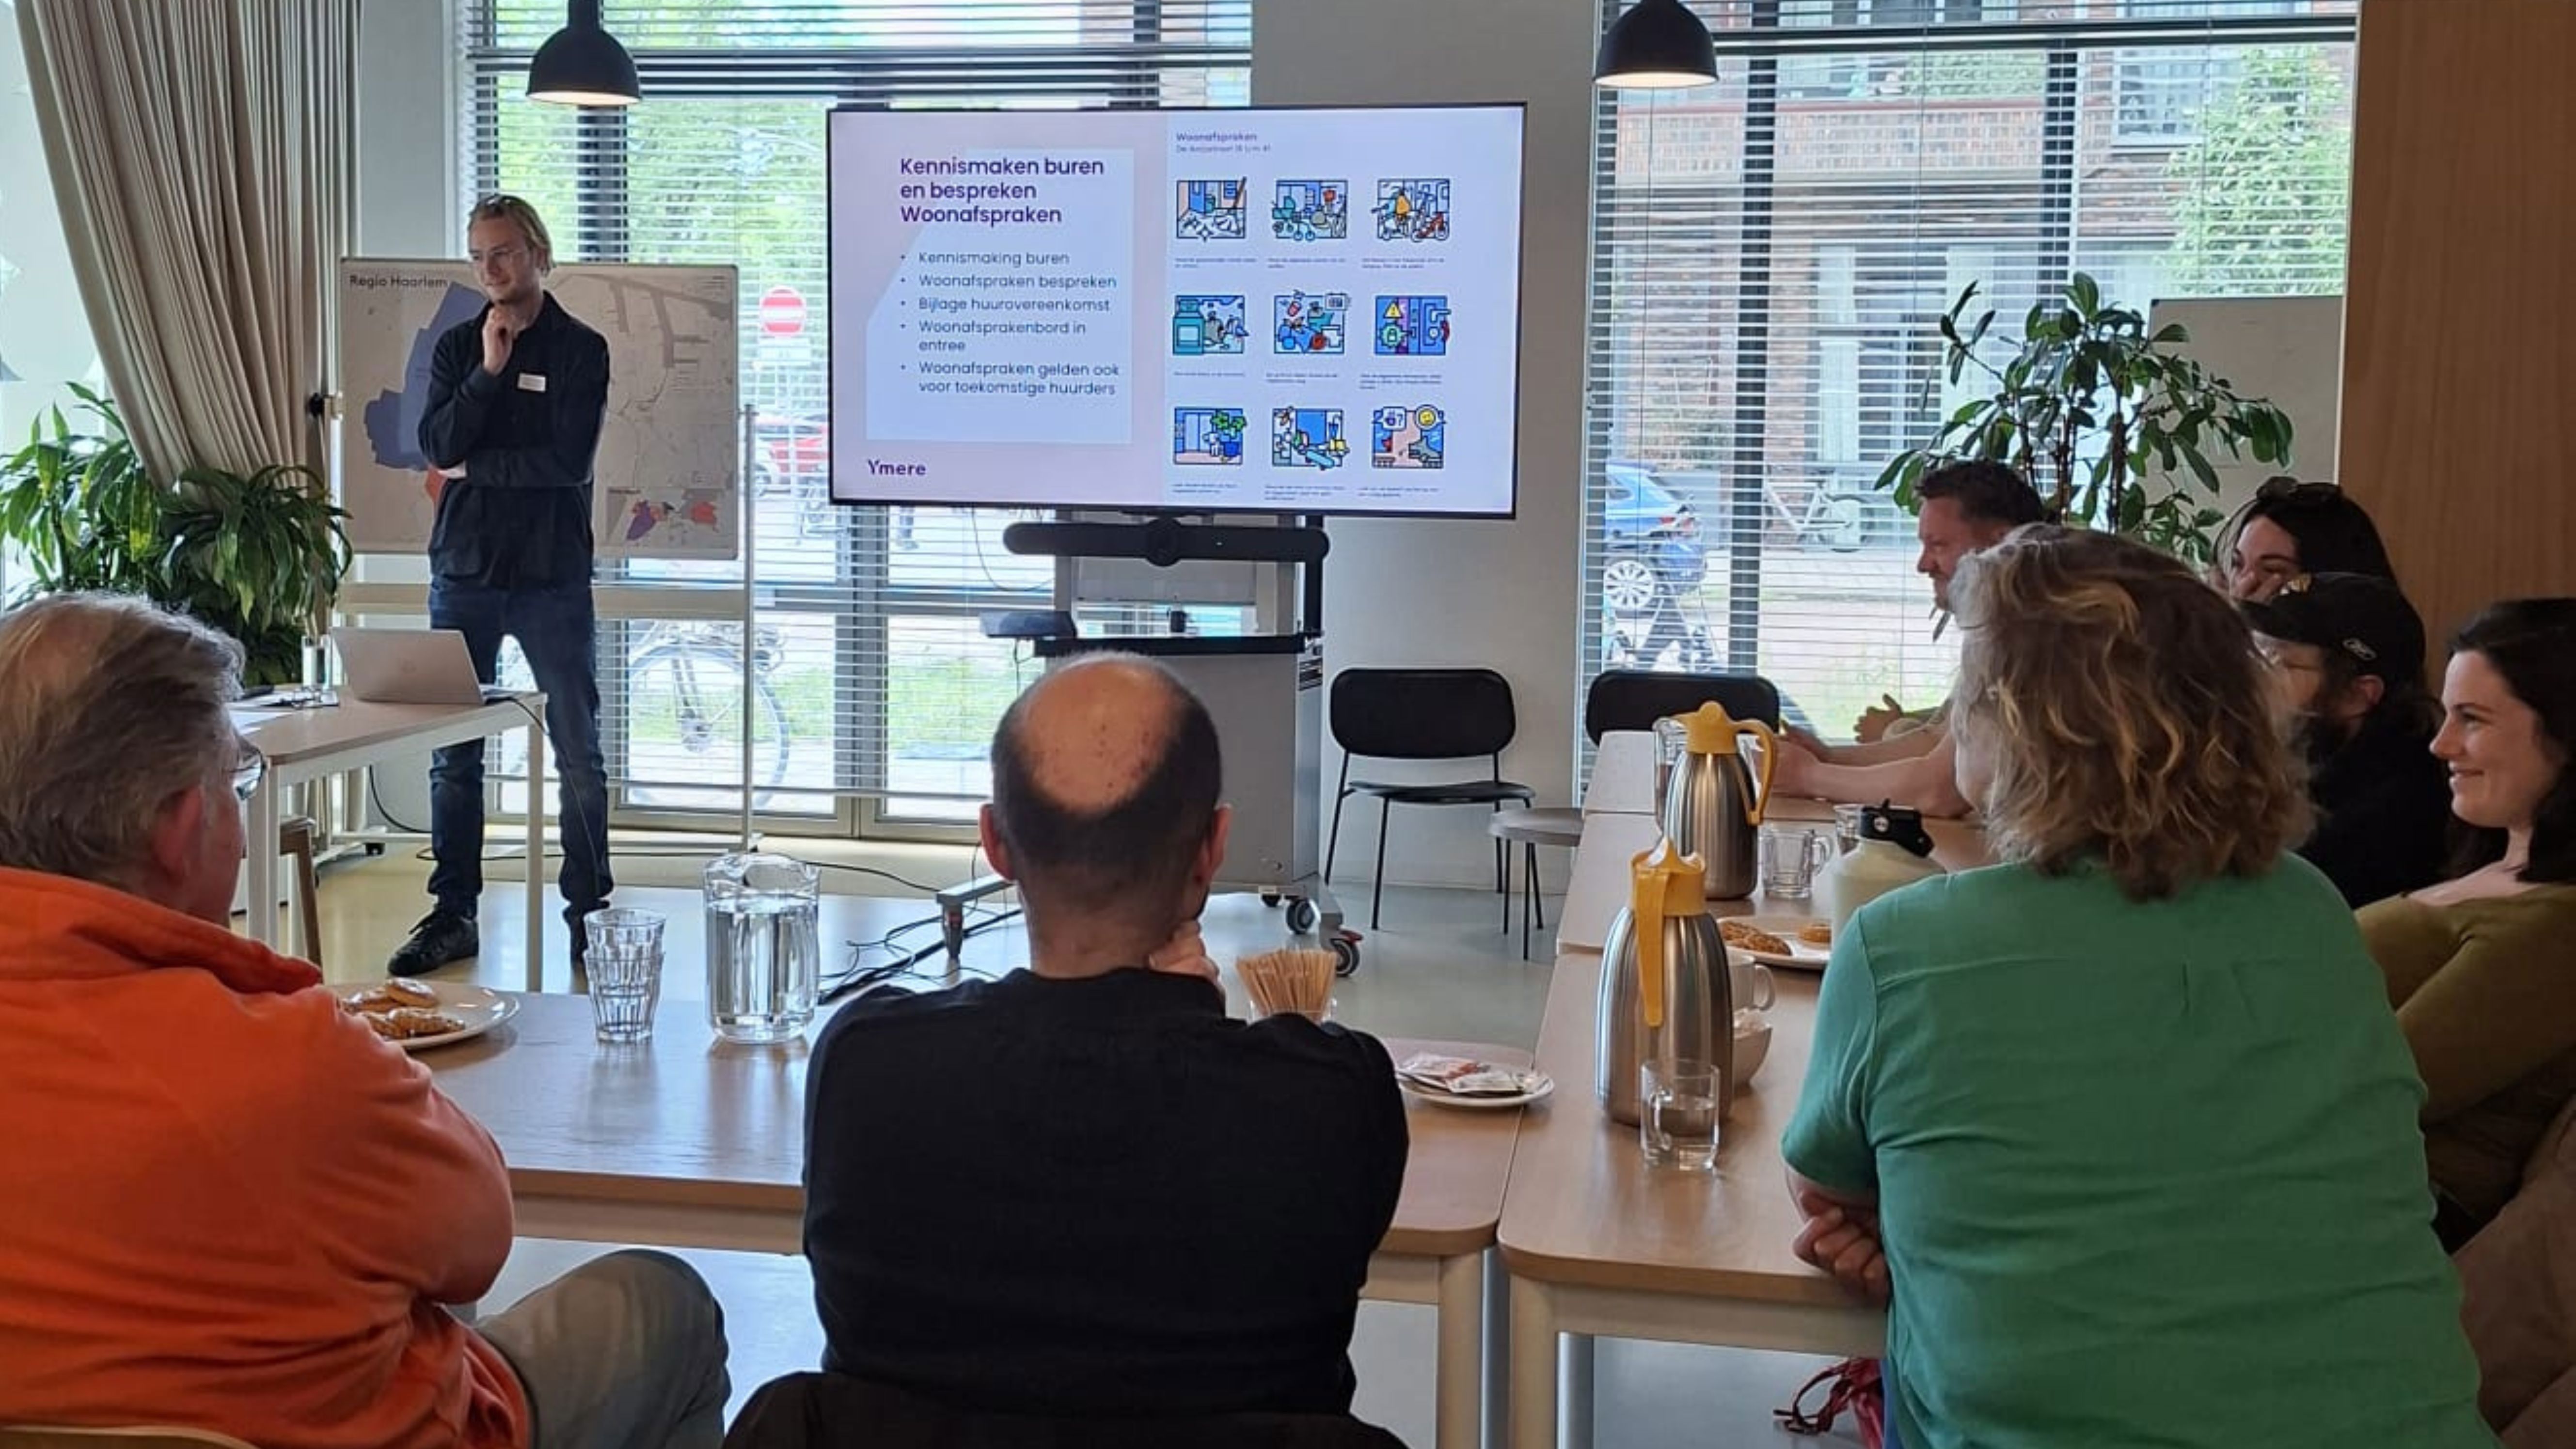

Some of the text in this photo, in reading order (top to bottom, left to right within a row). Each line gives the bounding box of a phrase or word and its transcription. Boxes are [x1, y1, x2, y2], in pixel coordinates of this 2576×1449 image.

[901, 156, 1104, 175] Kennismaken buren
[900, 181, 1037, 203] en bespreken
[900, 205, 1062, 228] Woonafspraken
[918, 252, 1070, 267] Kennismaking buren
[349, 274, 447, 290] Regio Haarlem
[918, 274, 1117, 291] Woonafspraken bespreken
[918, 296, 1110, 313] Bijlage huurovereenkomst
[918, 319, 1086, 336] Woonafsprakenbord in
[918, 339, 966, 352] entree
[918, 361, 1119, 379] Woonafspraken gelden ook
[918, 380, 1116, 397] voor toekomstige huurders
[868, 459, 926, 476] Ymere
